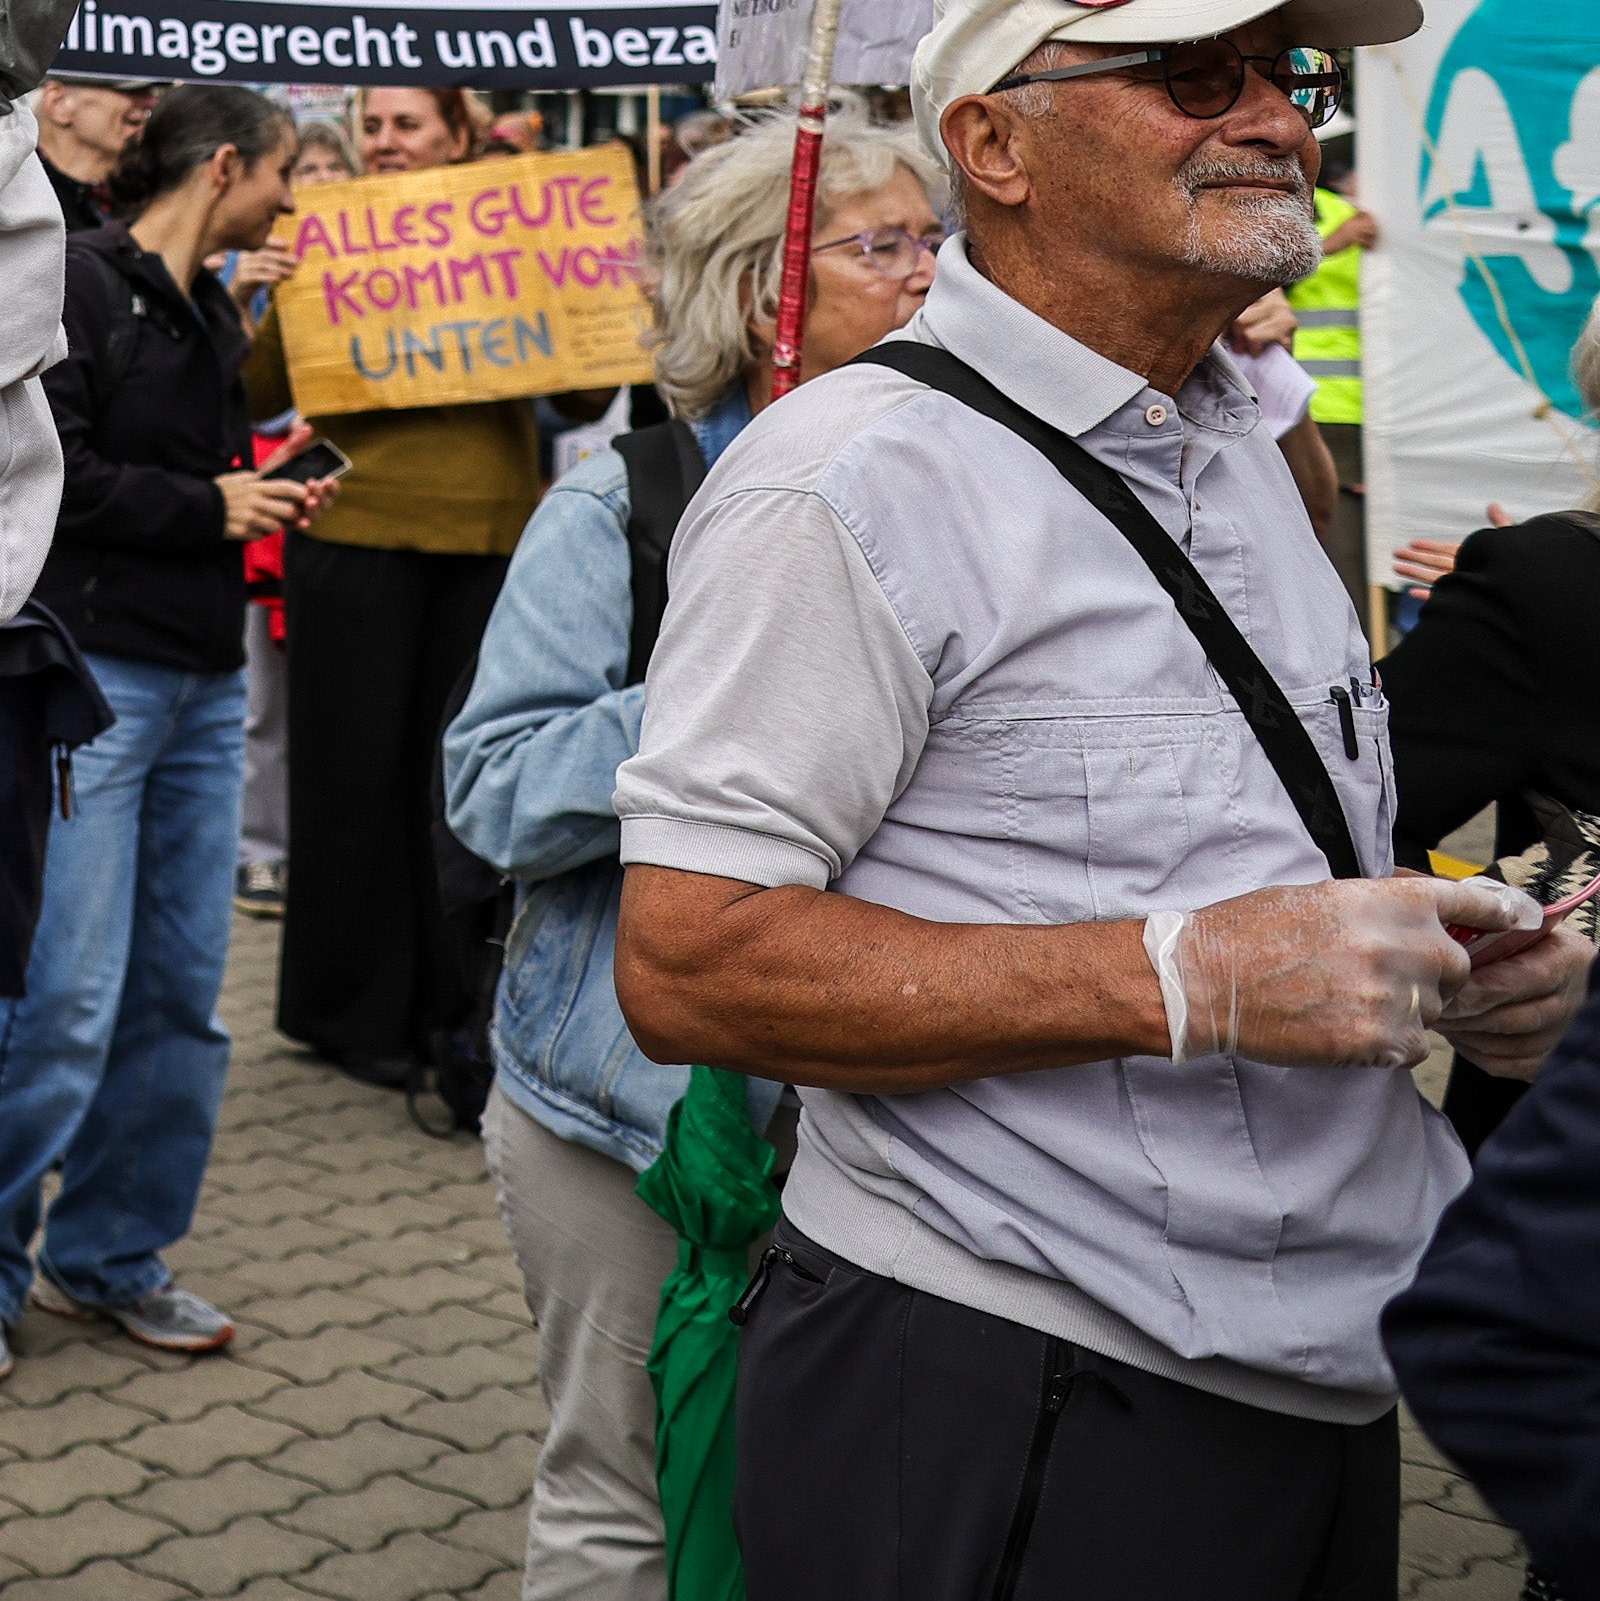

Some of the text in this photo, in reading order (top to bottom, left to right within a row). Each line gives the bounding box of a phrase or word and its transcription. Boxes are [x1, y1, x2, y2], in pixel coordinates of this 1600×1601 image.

[434, 18, 558, 68] und
[569, 17, 719, 68] beza
[295, 175, 616, 260] ALLES GUTE
[322, 248, 522, 325] KOMMT
[351, 309, 554, 381] UNTEN
